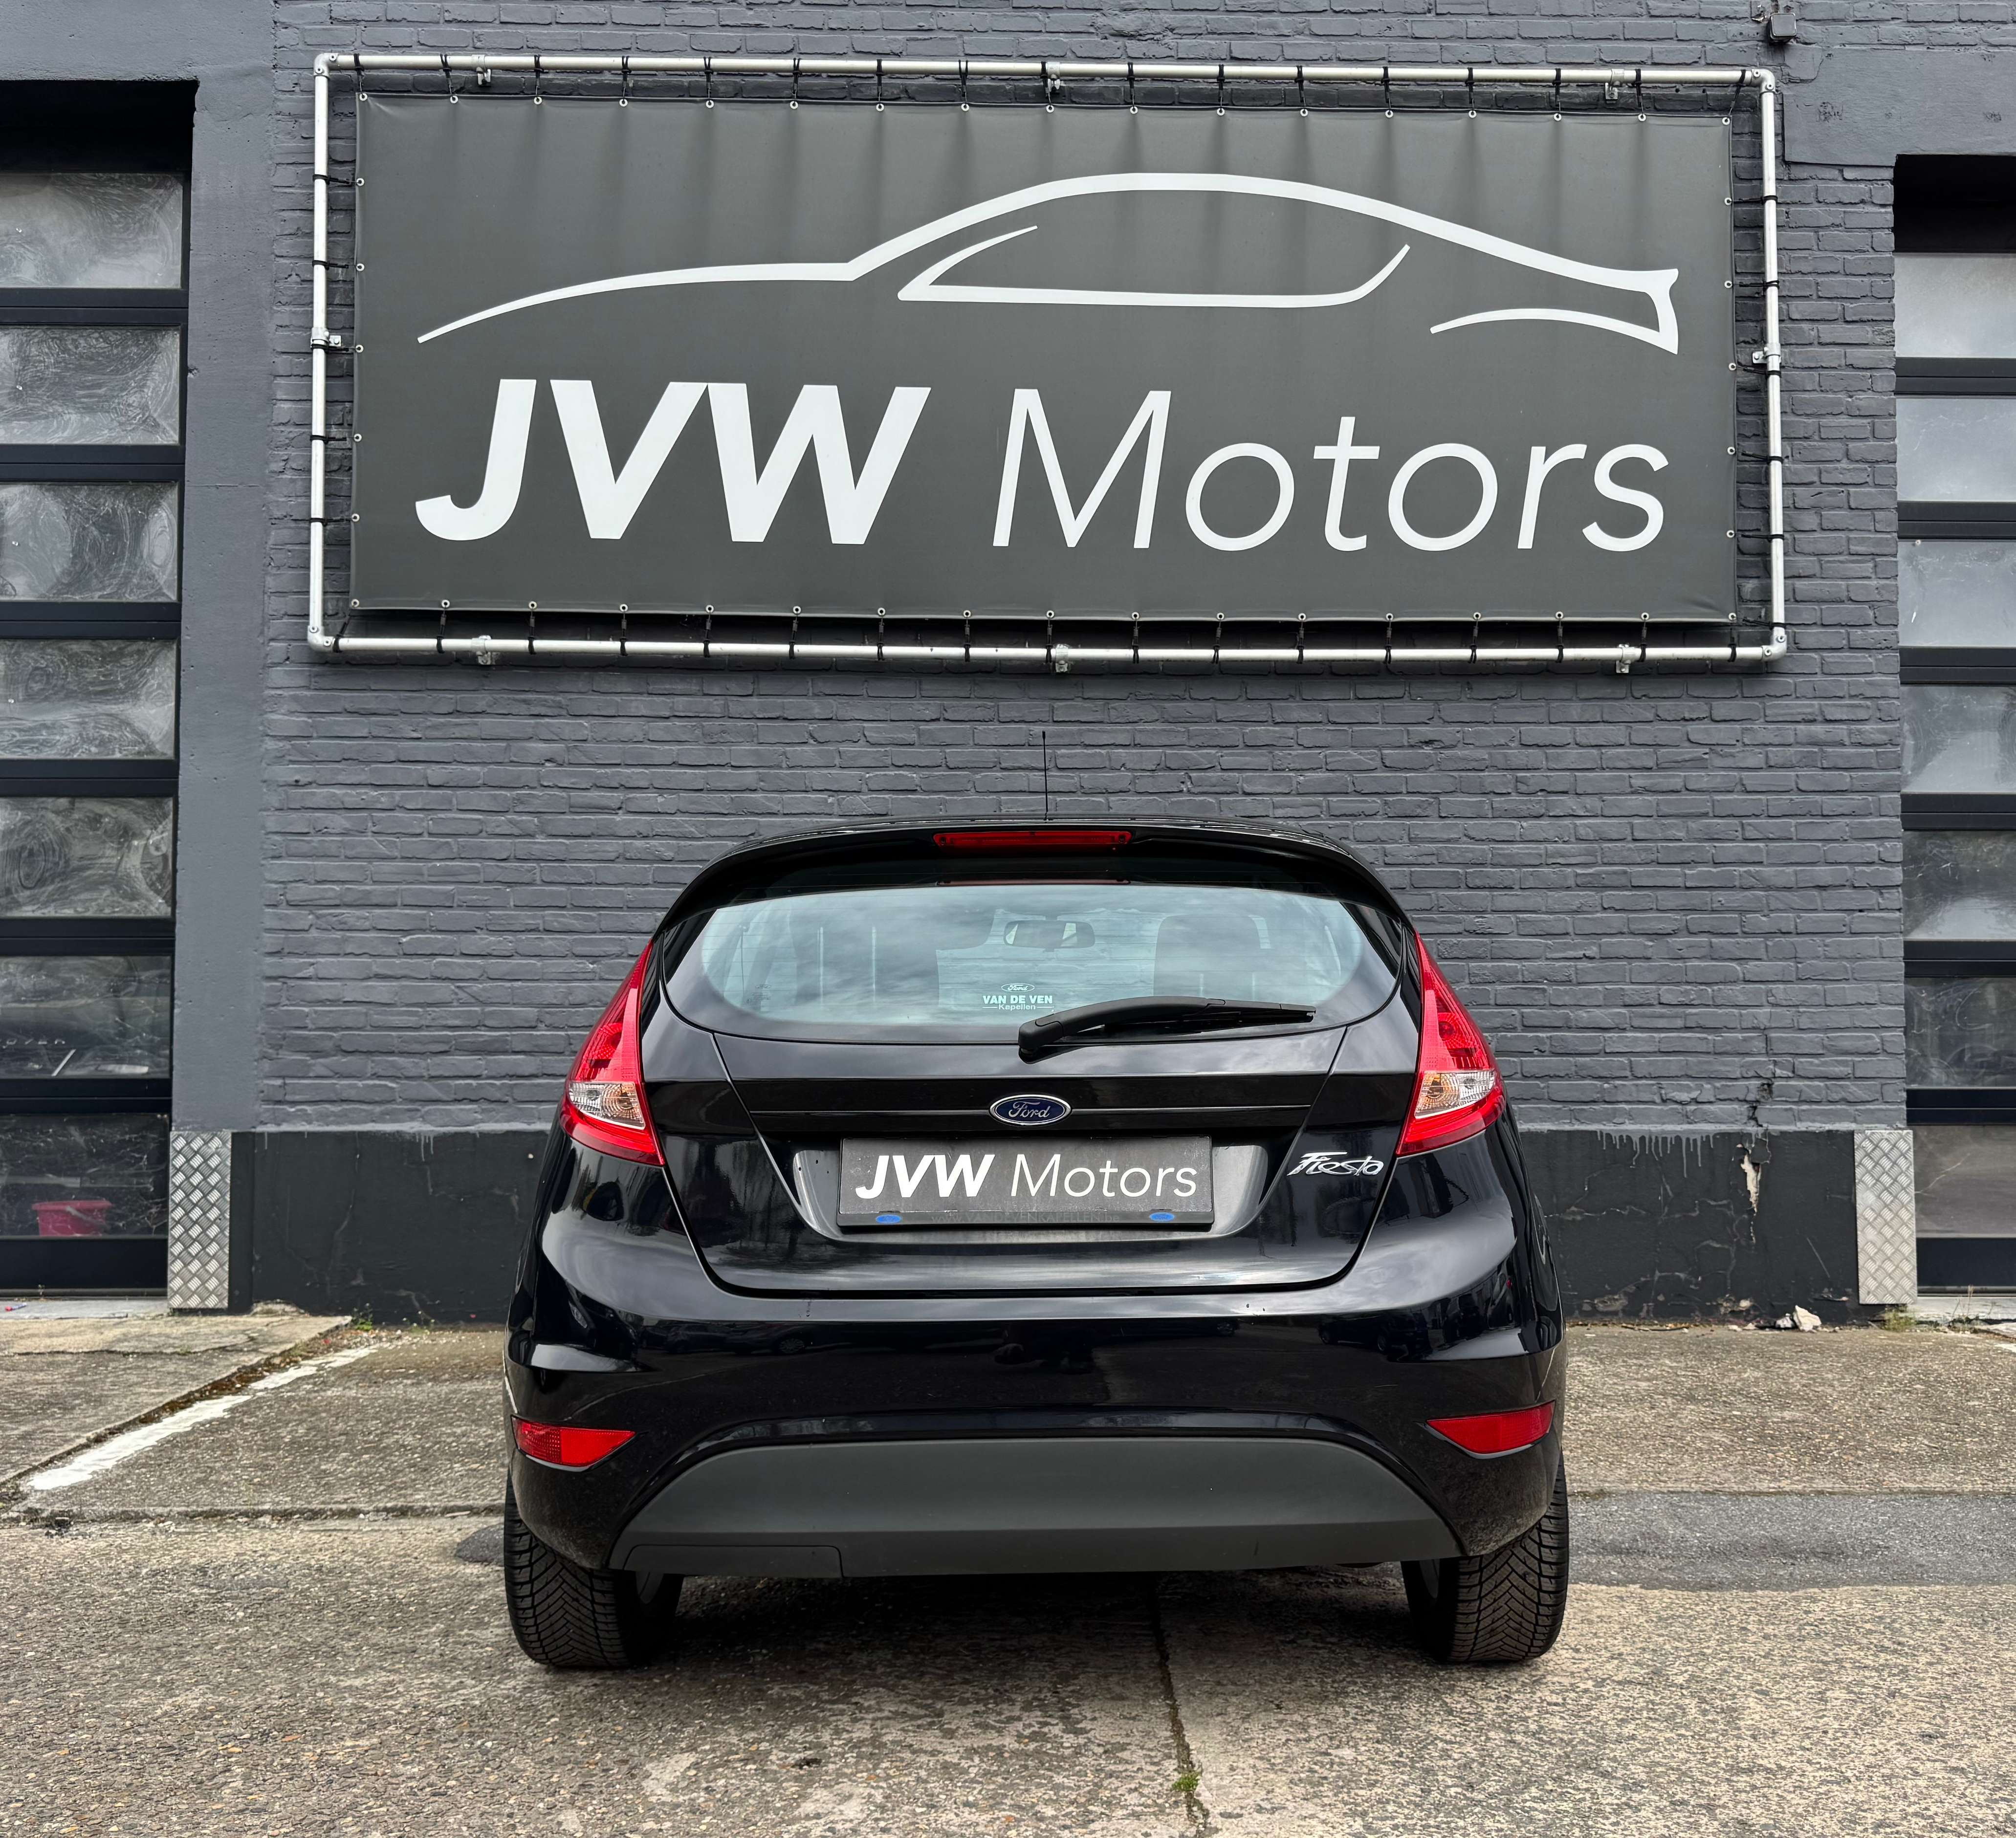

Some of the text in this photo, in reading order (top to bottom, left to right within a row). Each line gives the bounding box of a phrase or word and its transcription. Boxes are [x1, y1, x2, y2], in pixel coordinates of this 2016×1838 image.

[416, 379, 1668, 551] JVW Motors
[982, 995, 1053, 1004] VAN DE VEN
[1008, 1101, 1051, 1118] Ford
[1287, 1152, 1384, 1176] Fiesta
[855, 1154, 1197, 1199] JVW Motors
